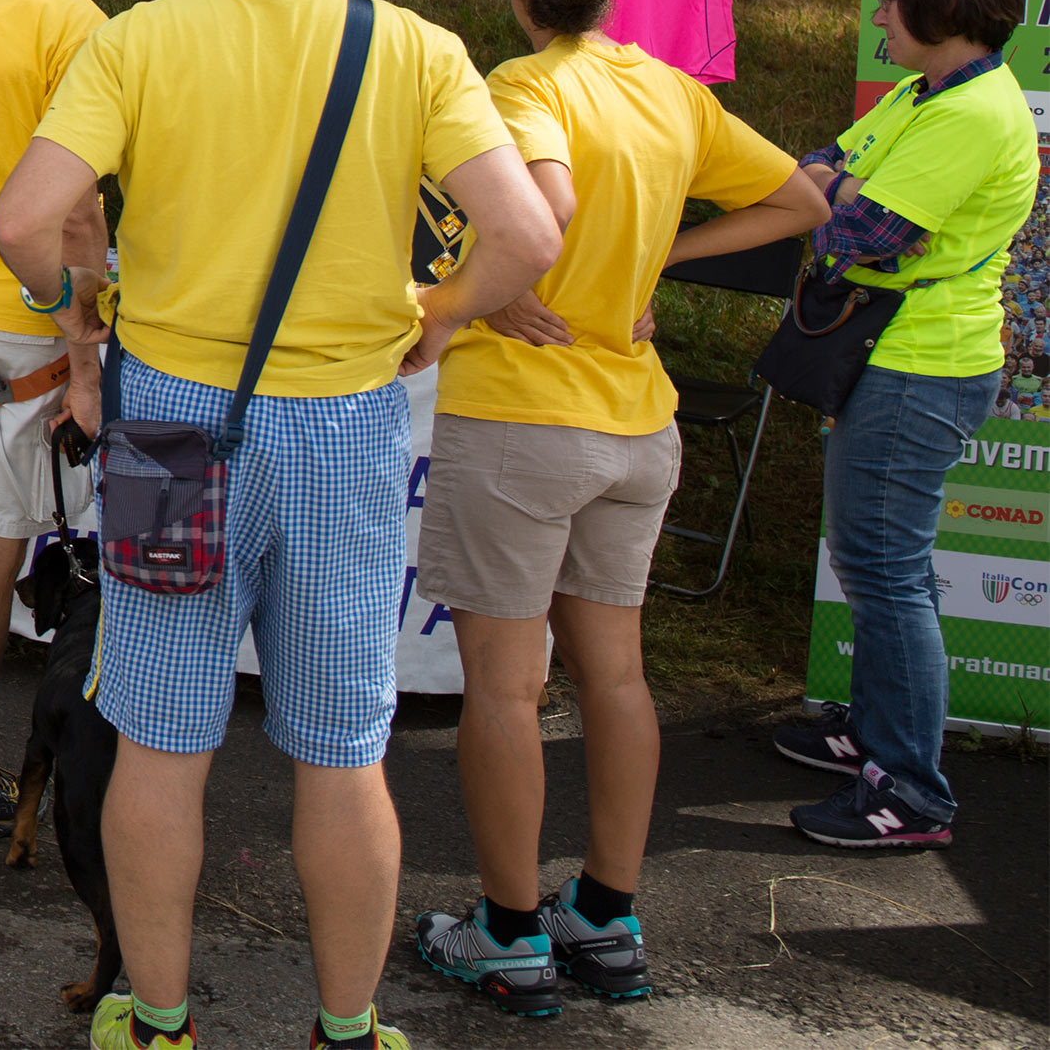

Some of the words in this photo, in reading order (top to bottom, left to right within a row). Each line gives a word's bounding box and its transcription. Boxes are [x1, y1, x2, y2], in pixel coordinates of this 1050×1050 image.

[966, 503, 1044, 526] CONAD
[982, 572, 1010, 582] Italia
[486, 957, 545, 970] SALOMON
